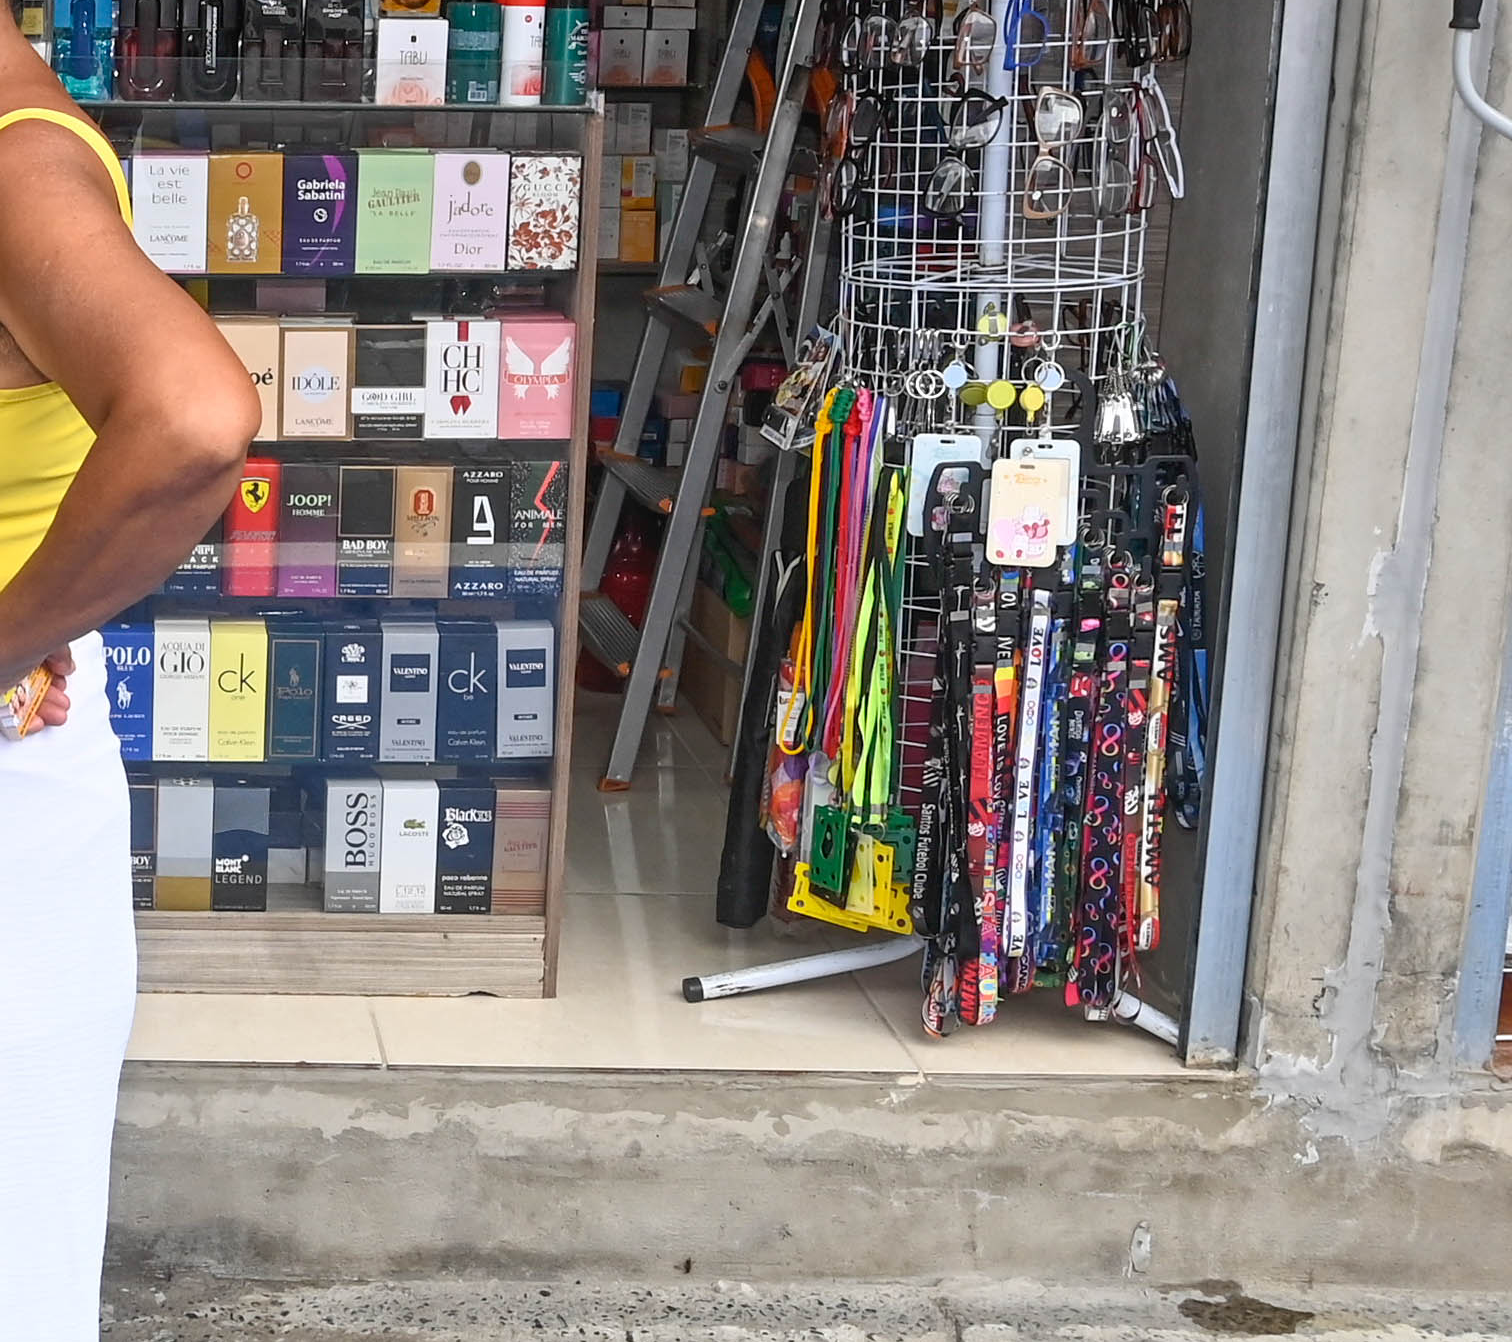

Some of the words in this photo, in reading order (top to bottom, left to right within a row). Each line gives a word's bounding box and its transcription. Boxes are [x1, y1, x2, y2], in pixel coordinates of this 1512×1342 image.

[400, 51, 428, 65] TABU
[149, 165, 164, 176] La
[170, 164, 189, 176] vie
[157, 180, 182, 189] est
[297, 179, 346, 190] Gabriela
[523, 183, 570, 192] GUCCI
[151, 191, 188, 205] belle
[297, 190, 345, 201] Sabatini
[454, 243, 483, 255] Dior
[443, 345, 481, 369] CH
[292, 373, 339, 390] IDÔLE
[443, 370, 480, 392] HC
[286, 494, 332, 507] JOOP!
[514, 510, 563, 520] ANIMALE
[342, 540, 364, 550] BAD
[368, 540, 389, 550] BOY
[160, 643, 192, 653] ACQUA
[195, 642, 205, 651] DI
[1030, 627, 1044, 667] LOVE
[102, 646, 151, 666] POLO
[160, 651, 205, 673] GIÒ
[448, 652, 488, 693] ck
[509, 662, 543, 670] VALENTINO
[218, 653, 257, 693] ck
[996, 715, 1008, 753] LOVE
[392, 739, 425, 747] VALENTINO
[919, 803, 936, 835] Santos
[345, 792, 369, 868] BOSS
[915, 836, 932, 872] Futebol
[216, 858, 242, 866] MONT
[216, 866, 242, 874] BLANC
[215, 874, 263, 884] LEGEND
[913, 873, 927, 900] Clube
